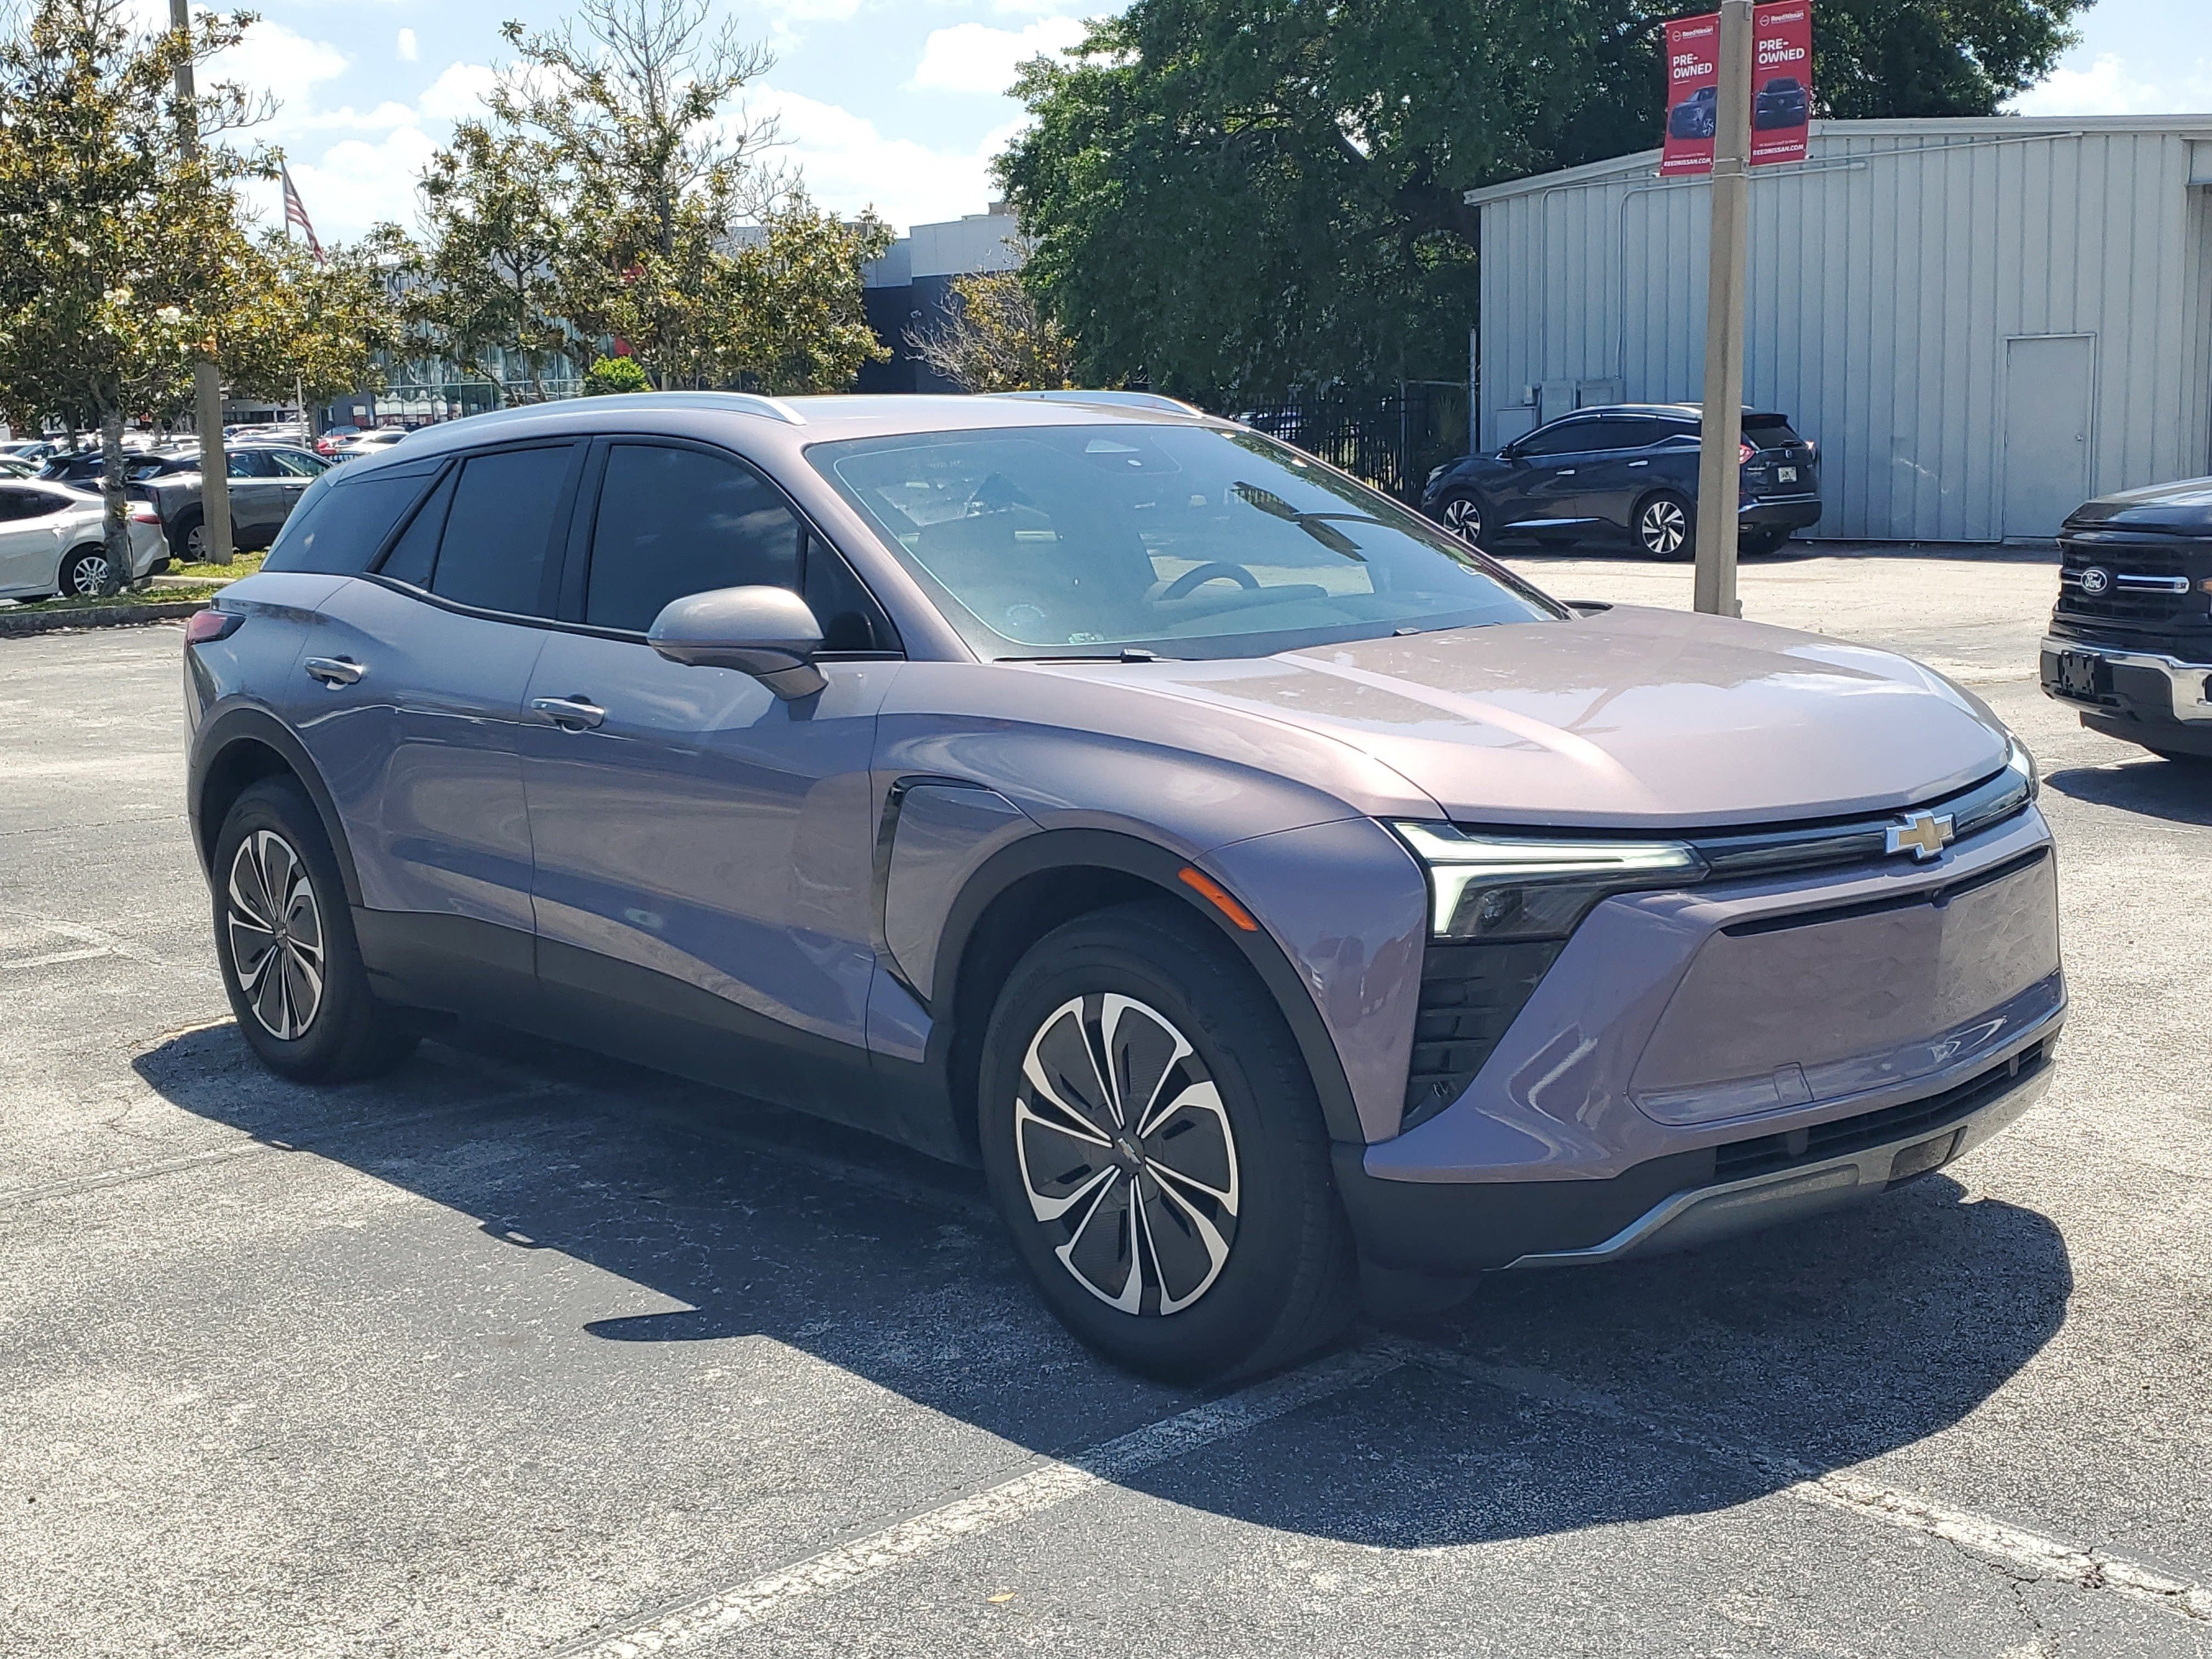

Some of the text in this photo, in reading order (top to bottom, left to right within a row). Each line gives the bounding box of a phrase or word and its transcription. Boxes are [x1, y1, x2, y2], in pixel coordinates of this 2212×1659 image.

[1759, 38, 1789, 52] PRE-
[1673, 54, 1699, 67] PRE-
[1759, 48, 1805, 64] OWNED
[1674, 63, 1713, 78] OWNED
[2085, 573, 2102, 588] Ford
